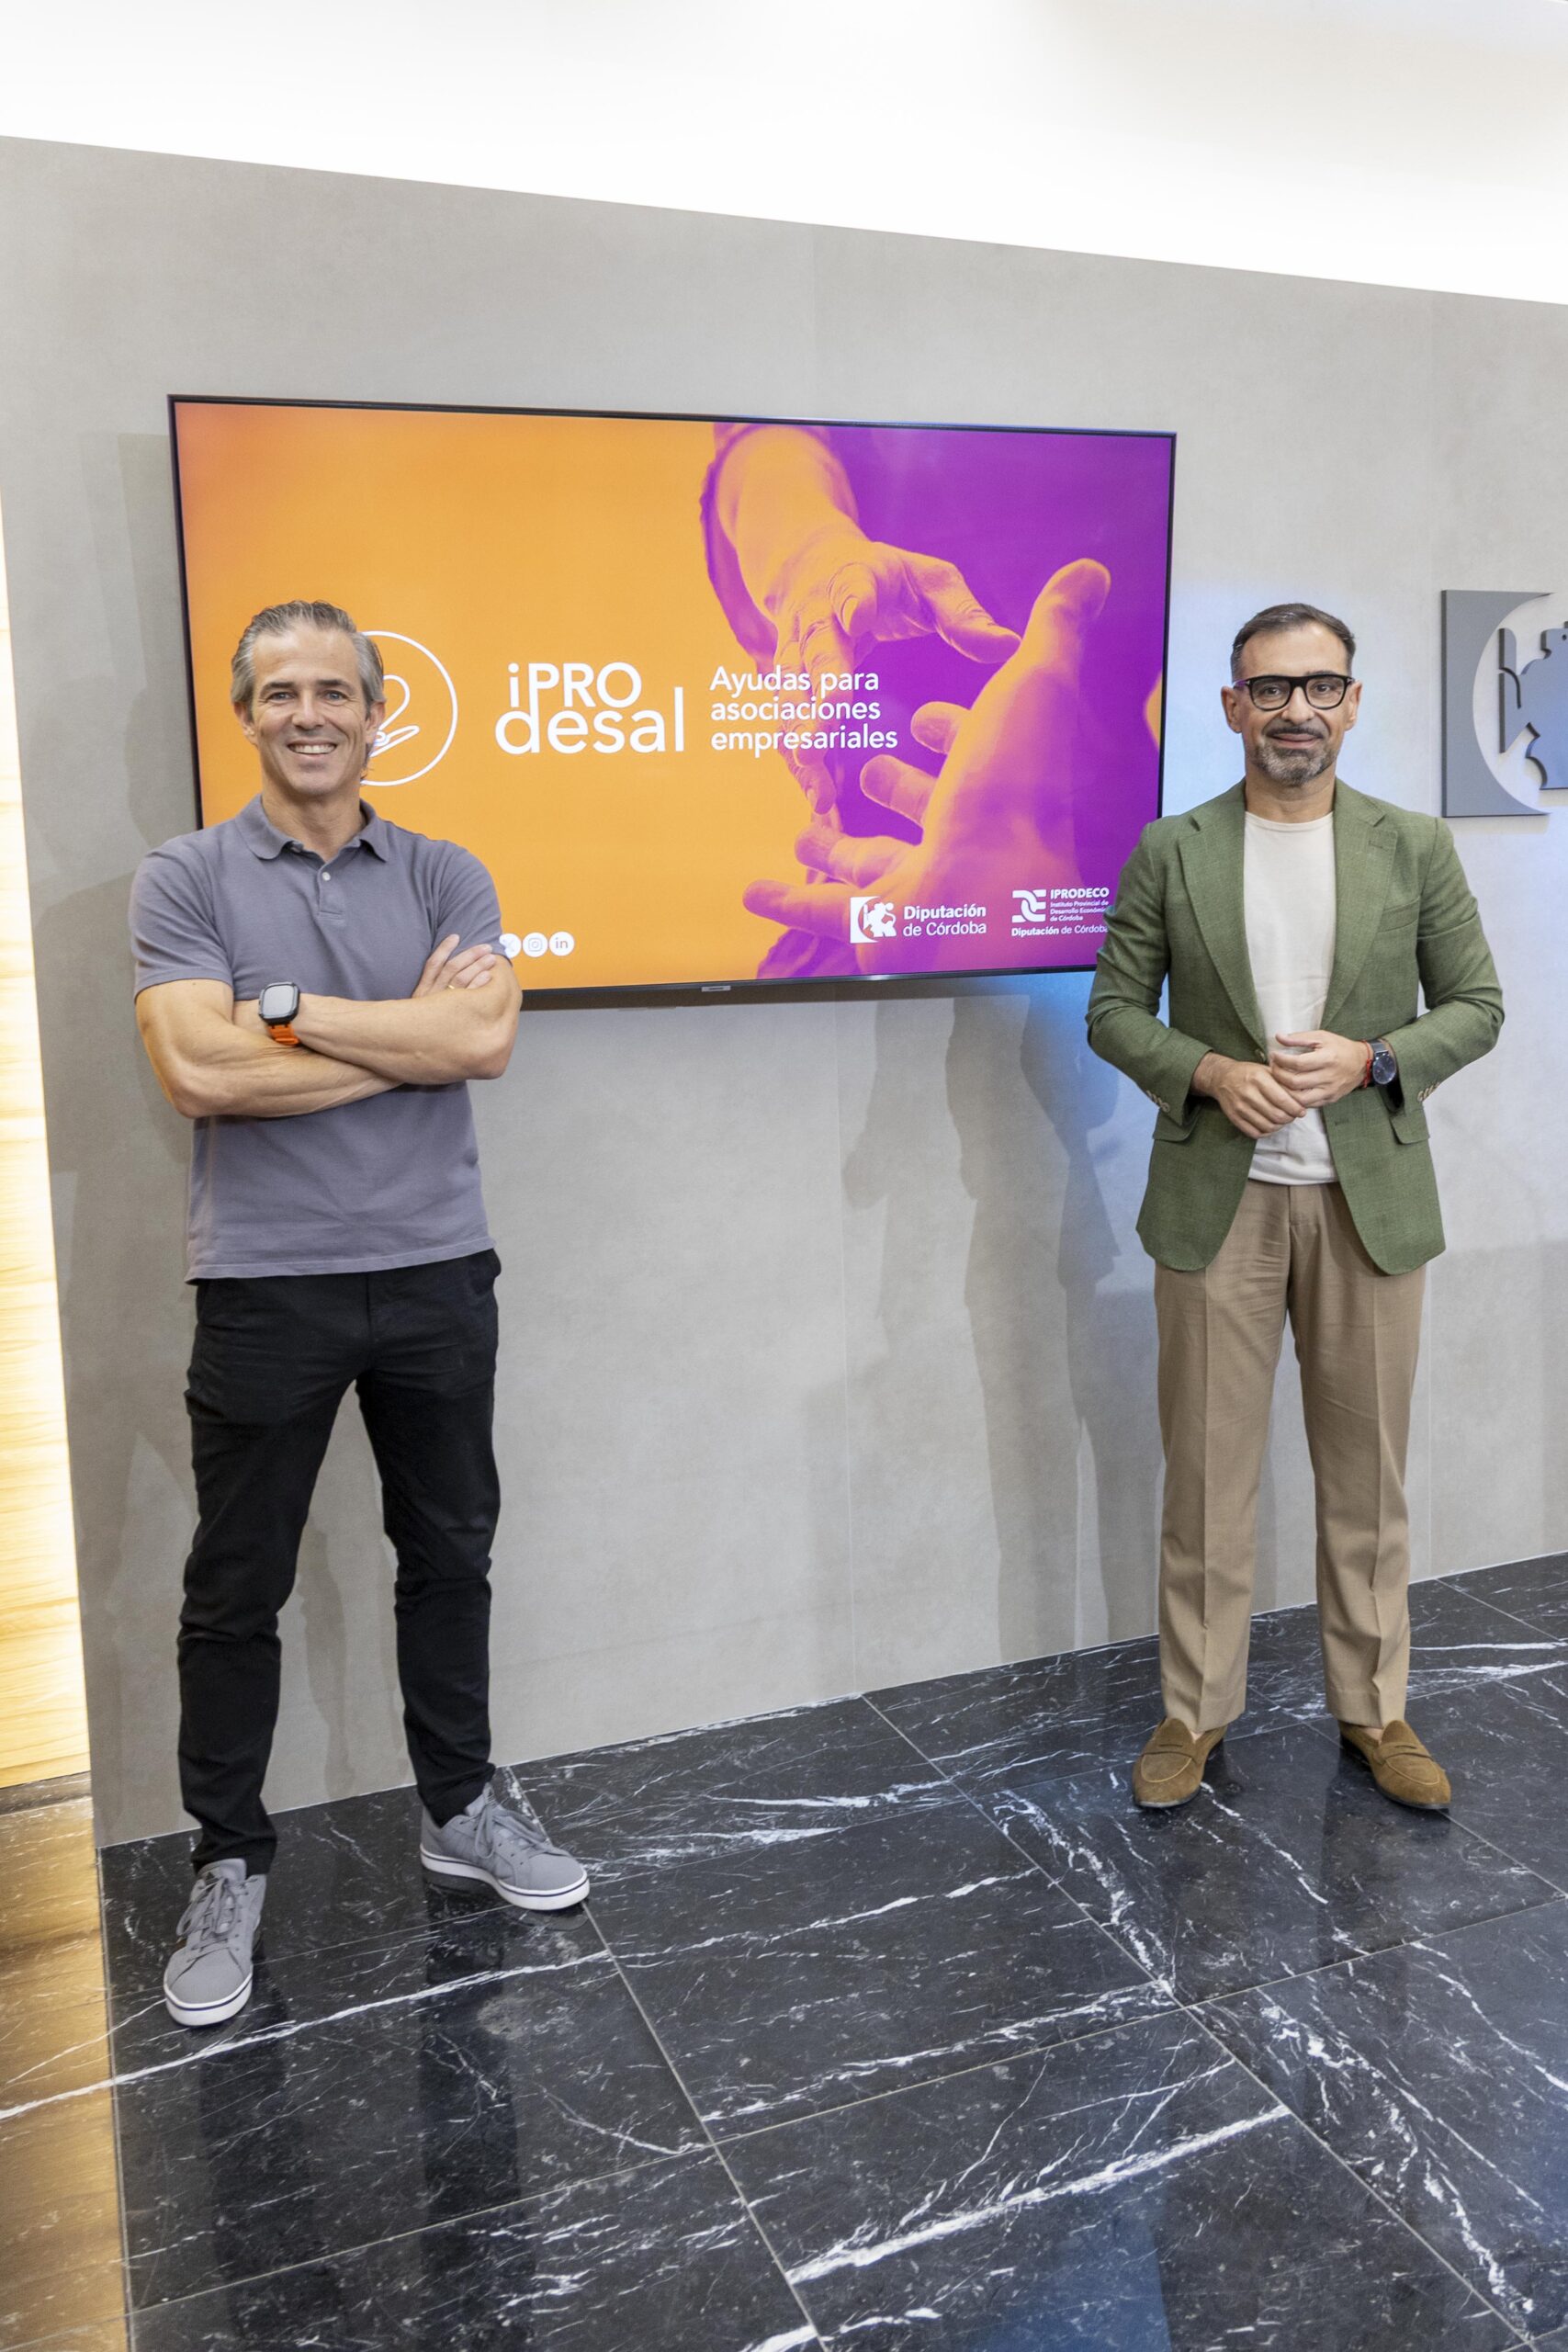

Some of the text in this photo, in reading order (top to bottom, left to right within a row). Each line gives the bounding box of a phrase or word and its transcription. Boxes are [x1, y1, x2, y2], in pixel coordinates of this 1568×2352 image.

[508, 662, 642, 708] iPRO
[709, 664, 879, 699] Ayudas para
[494, 686, 685, 755] desal
[710, 695, 881, 721] asociaciones
[710, 722, 898, 758] empresariales
[1050, 887, 1110, 899] IPRODECO
[903, 904, 987, 922] Diputación
[902, 921, 987, 936] de Córdoba
[1011, 926, 1059, 937] Diputación
[1060, 925, 1073, 934] de
